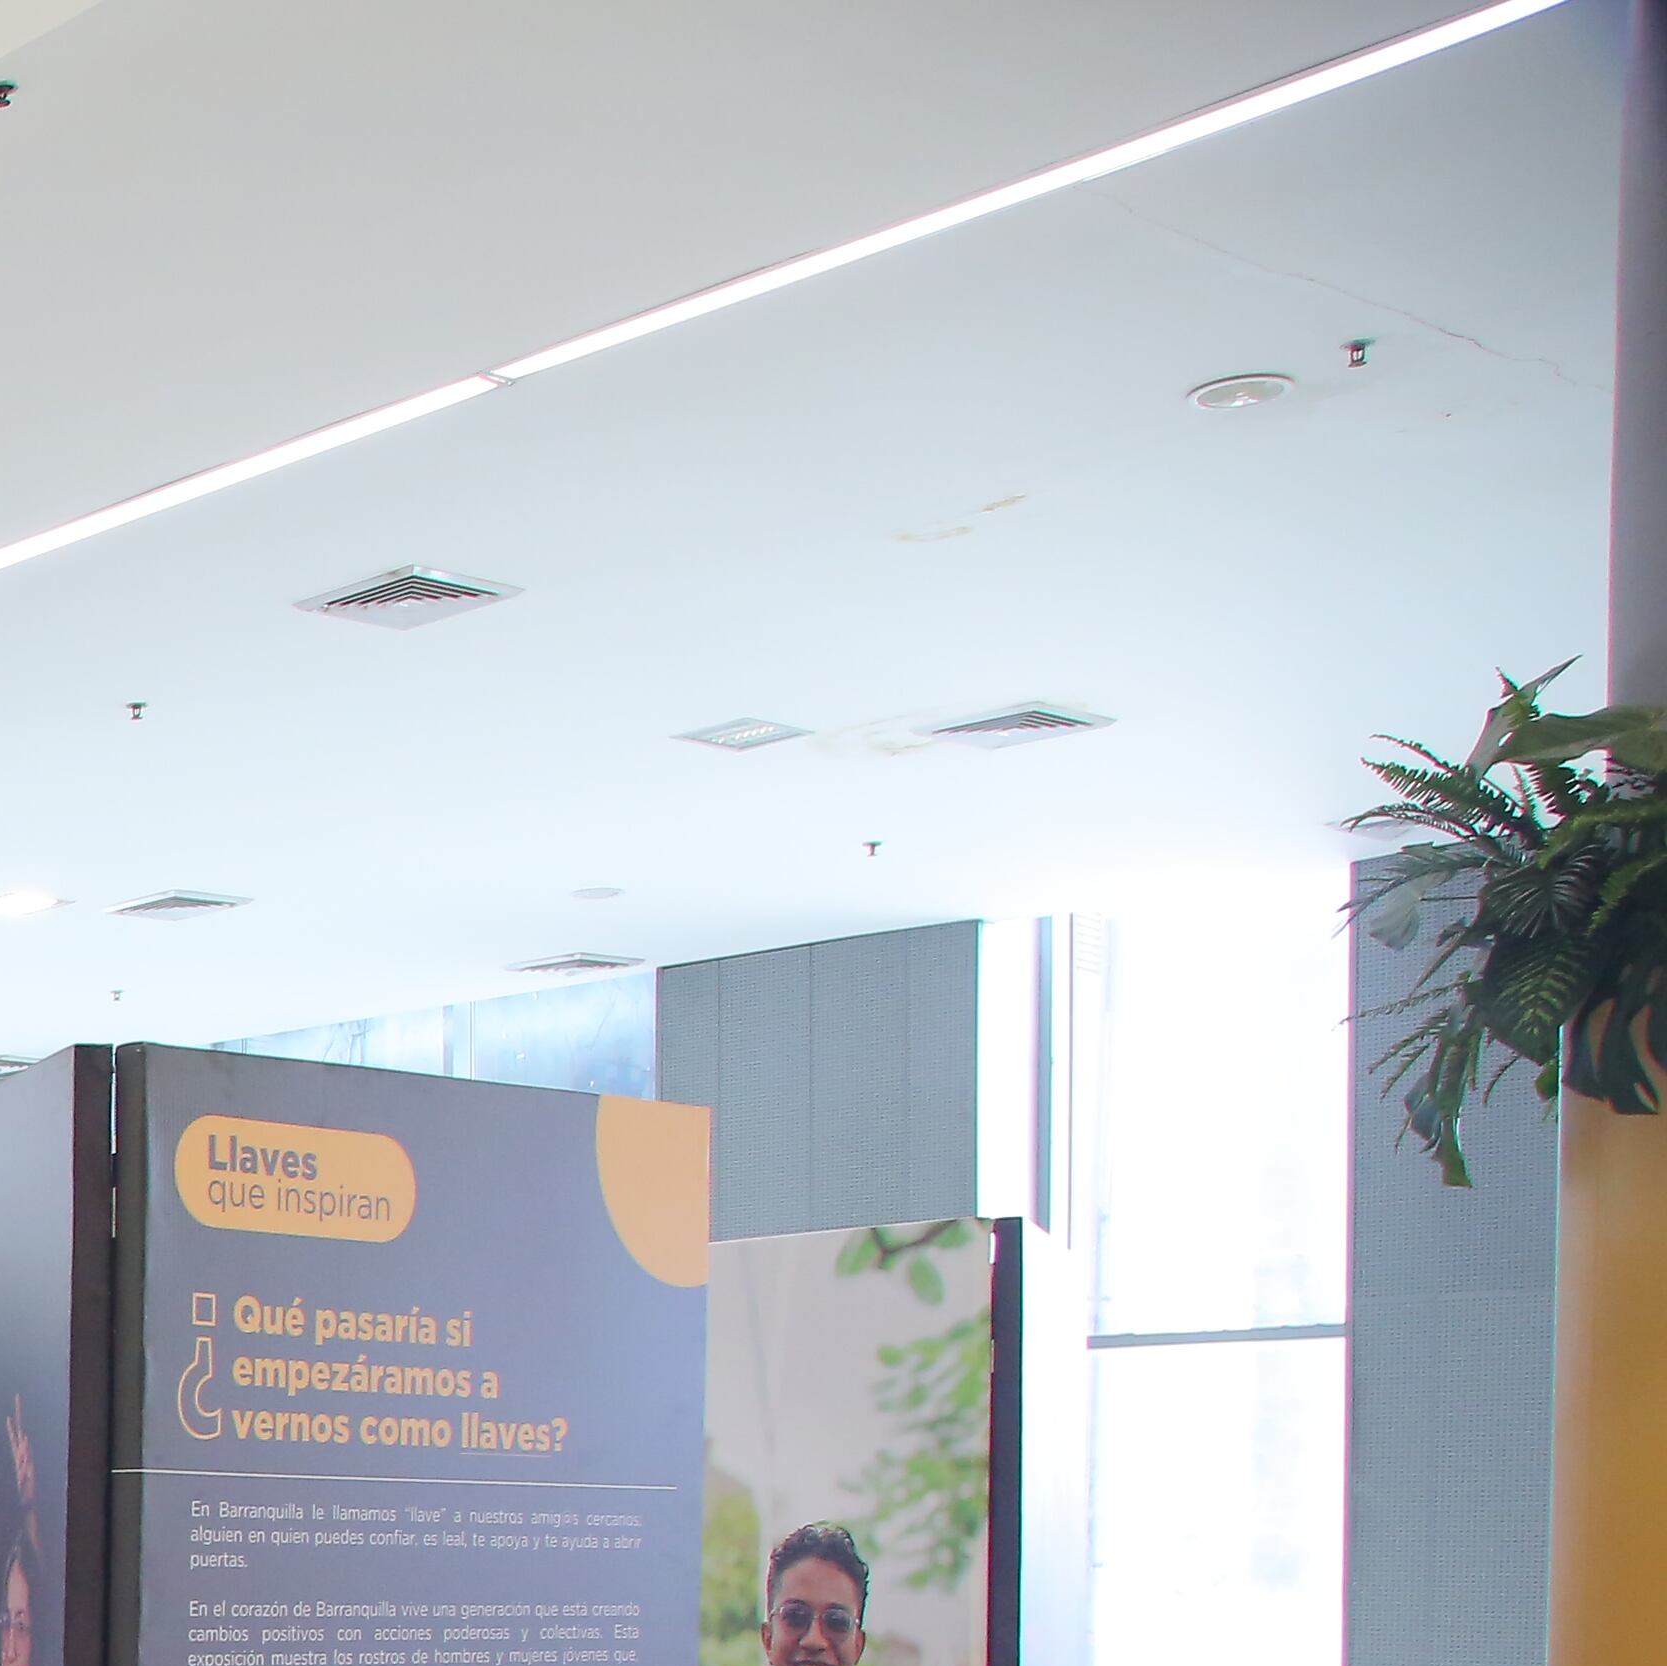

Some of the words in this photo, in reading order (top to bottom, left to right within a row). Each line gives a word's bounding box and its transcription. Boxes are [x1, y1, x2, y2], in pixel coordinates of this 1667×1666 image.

[208, 1135, 318, 1181] Llaves
[208, 1180, 265, 1212] que
[277, 1180, 391, 1221] inspiran
[234, 1296, 306, 1335] Qué
[316, 1308, 439, 1344] pasaría
[447, 1312, 473, 1345] si
[233, 1354, 472, 1396] empezáramos
[481, 1370, 501, 1398] a
[234, 1411, 352, 1442] vernos
[360, 1417, 453, 1446] como
[461, 1413, 568, 1450] llaves?
